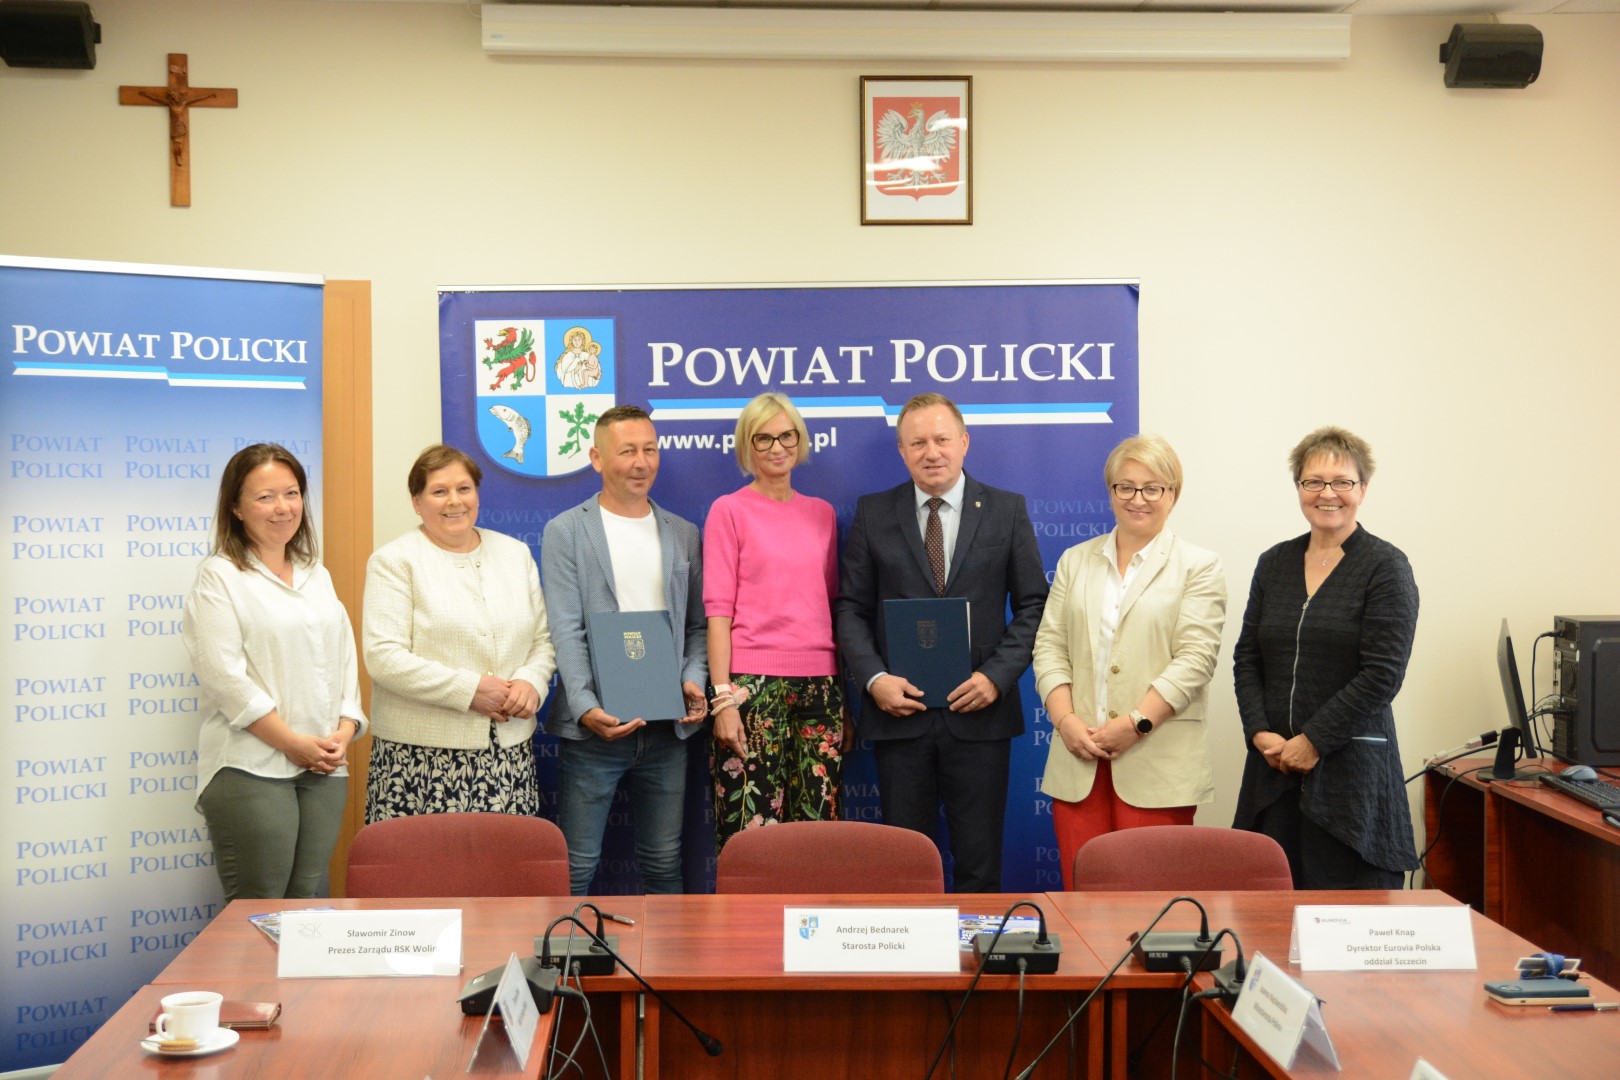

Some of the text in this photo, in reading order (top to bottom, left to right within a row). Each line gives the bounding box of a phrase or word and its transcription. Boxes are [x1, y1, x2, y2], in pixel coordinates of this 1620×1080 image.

[12, 324, 308, 363] POWIAT POLICKI
[647, 339, 1115, 386] POWIAT POLICKI
[10, 433, 103, 452] POWIAT
[125, 435, 210, 453] POWIAT
[10, 460, 103, 478] POLICKI
[125, 461, 211, 479] POLICKI
[13, 515, 104, 533] POWIAT
[126, 515, 211, 532] POWIAT
[12, 542, 104, 560] POLICKI
[126, 540, 212, 558] POLICKI
[14, 597, 105, 615] POWIAT
[128, 593, 184, 611] POWI
[14, 623, 105, 641] POLICKI
[15, 676, 106, 696] POWIAT
[129, 672, 200, 689] POWIA
[15, 703, 106, 723] POLICKI
[128, 697, 199, 715] POLIC
[16, 757, 107, 777] POWIAT
[129, 750, 199, 769] POWIA
[16, 782, 107, 804] POLICKI
[129, 775, 198, 795] POLIC
[16, 836, 108, 859] POWIAT
[130, 851, 216, 874] POLICKI
[16, 862, 107, 886] POLICKI
[130, 904, 216, 928] POWIAT
[16, 916, 108, 941] POWIAT
[347, 929, 416, 937] Sławomir Zinow
[836, 925, 909, 934] Andrzej Bednarek
[1395, 929, 1415, 938] Knap
[130, 931, 201, 953] POLIC
[328, 946, 356, 954] Prezes
[358, 945, 392, 955] Zarządu
[394, 945, 411, 953] RSK
[842, 942, 905, 950] Starosta Policki
[1346, 944, 1441, 953] Dyrektor Eurovia Polska
[16, 942, 108, 968] POLICKI
[1394, 958, 1427, 966] Szczecin
[17, 997, 109, 1024] POWIAT
[16, 1024, 100, 1052] POLICK
